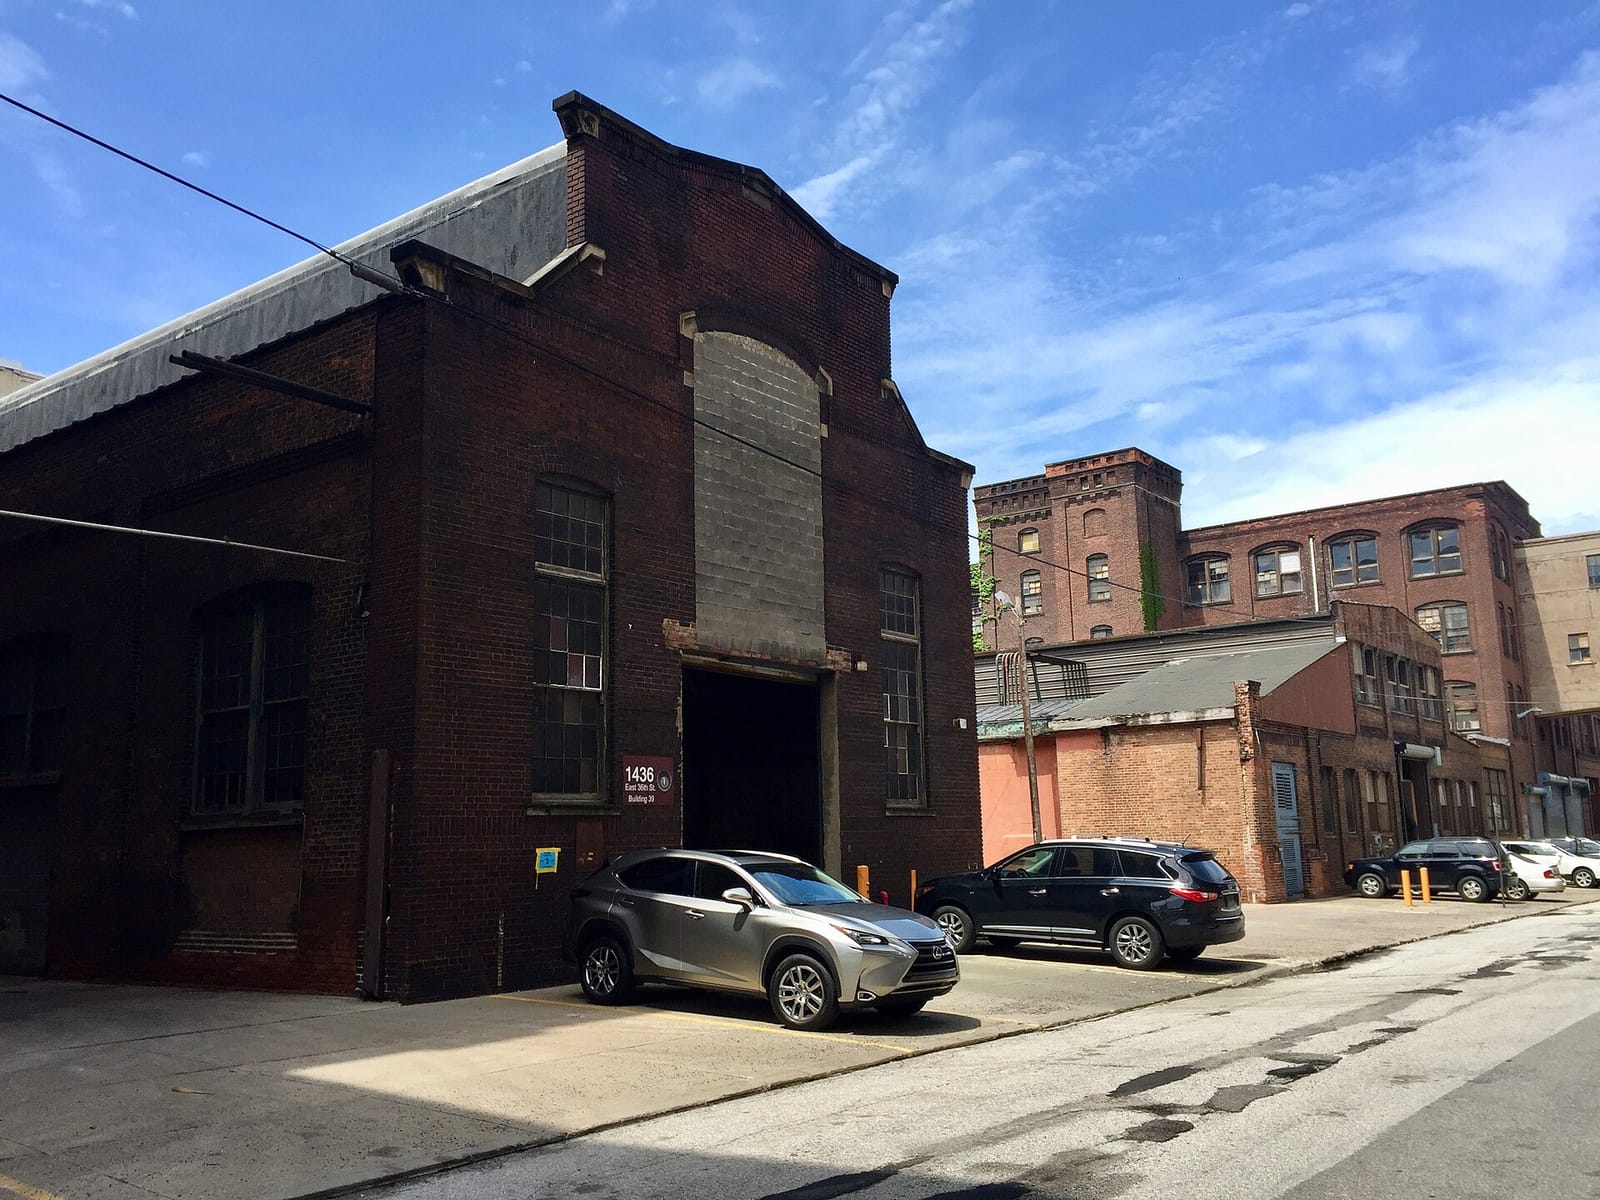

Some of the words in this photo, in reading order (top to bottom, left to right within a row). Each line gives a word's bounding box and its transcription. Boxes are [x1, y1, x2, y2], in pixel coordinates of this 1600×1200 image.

[625, 766, 654, 782] 1436
[624, 783, 636, 791] East
[628, 795, 647, 804] Building
